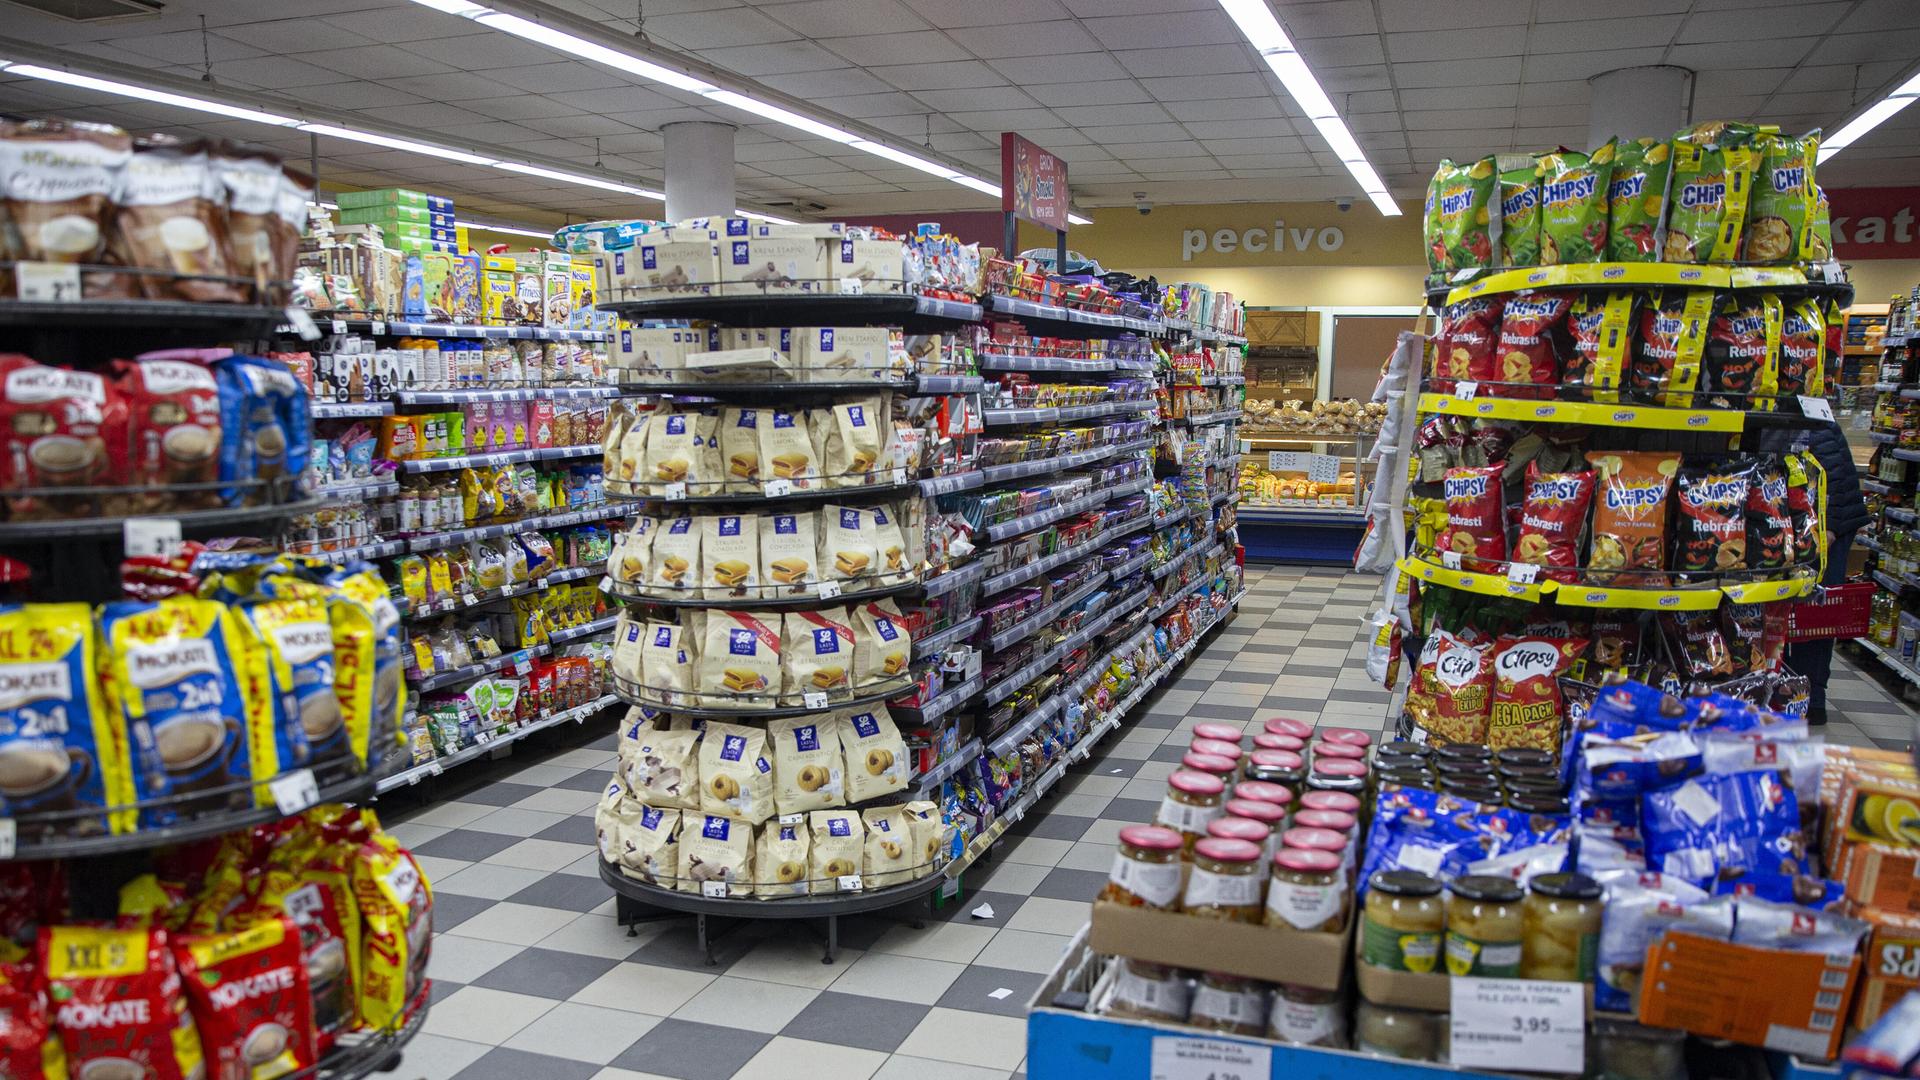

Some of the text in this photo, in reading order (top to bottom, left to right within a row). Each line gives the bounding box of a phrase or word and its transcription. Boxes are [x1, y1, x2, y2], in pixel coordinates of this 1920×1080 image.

[1610, 172, 1647, 200] iPSY
[1772, 167, 1805, 193] CHi
[1442, 188, 1475, 215] HiPSY
[1502, 186, 1541, 216] HiPSY
[1682, 183, 1726, 208] CHiP
[1831, 206, 1920, 245] kat
[1182, 218, 1345, 262] pecivo
[572, 270, 591, 283] Nesquik
[491, 281, 511, 293] Nesquik
[517, 281, 541, 298] Fitness
[1578, 312, 1605, 335] CHiP
[1653, 318, 1685, 336] CHiP
[1783, 319, 1812, 337] CHi
[1575, 341, 1600, 352] ebra
[1643, 342, 1678, 359] Rebra
[1728, 345, 1768, 358] Rebra
[1783, 345, 1818, 358] Rebra
[1444, 475, 1488, 500] CHiPSY
[1606, 483, 1667, 511] CHiPSY
[1693, 519, 1745, 532] Rebrasti
[751, 619, 771, 637] FAMILY
[282, 630, 331, 646] MOKAT
[758, 630, 774, 647] PACK
[134, 648, 208, 671] MOKATE
[1441, 656, 1474, 678] Clip
[1502, 650, 1556, 671] Clipsy
[0, 670, 60, 692] OKATE
[434, 711, 459, 720] VIVIL
[1523, 702, 1556, 723] PACK
[1512, 1016, 1551, 1034] 3,95
